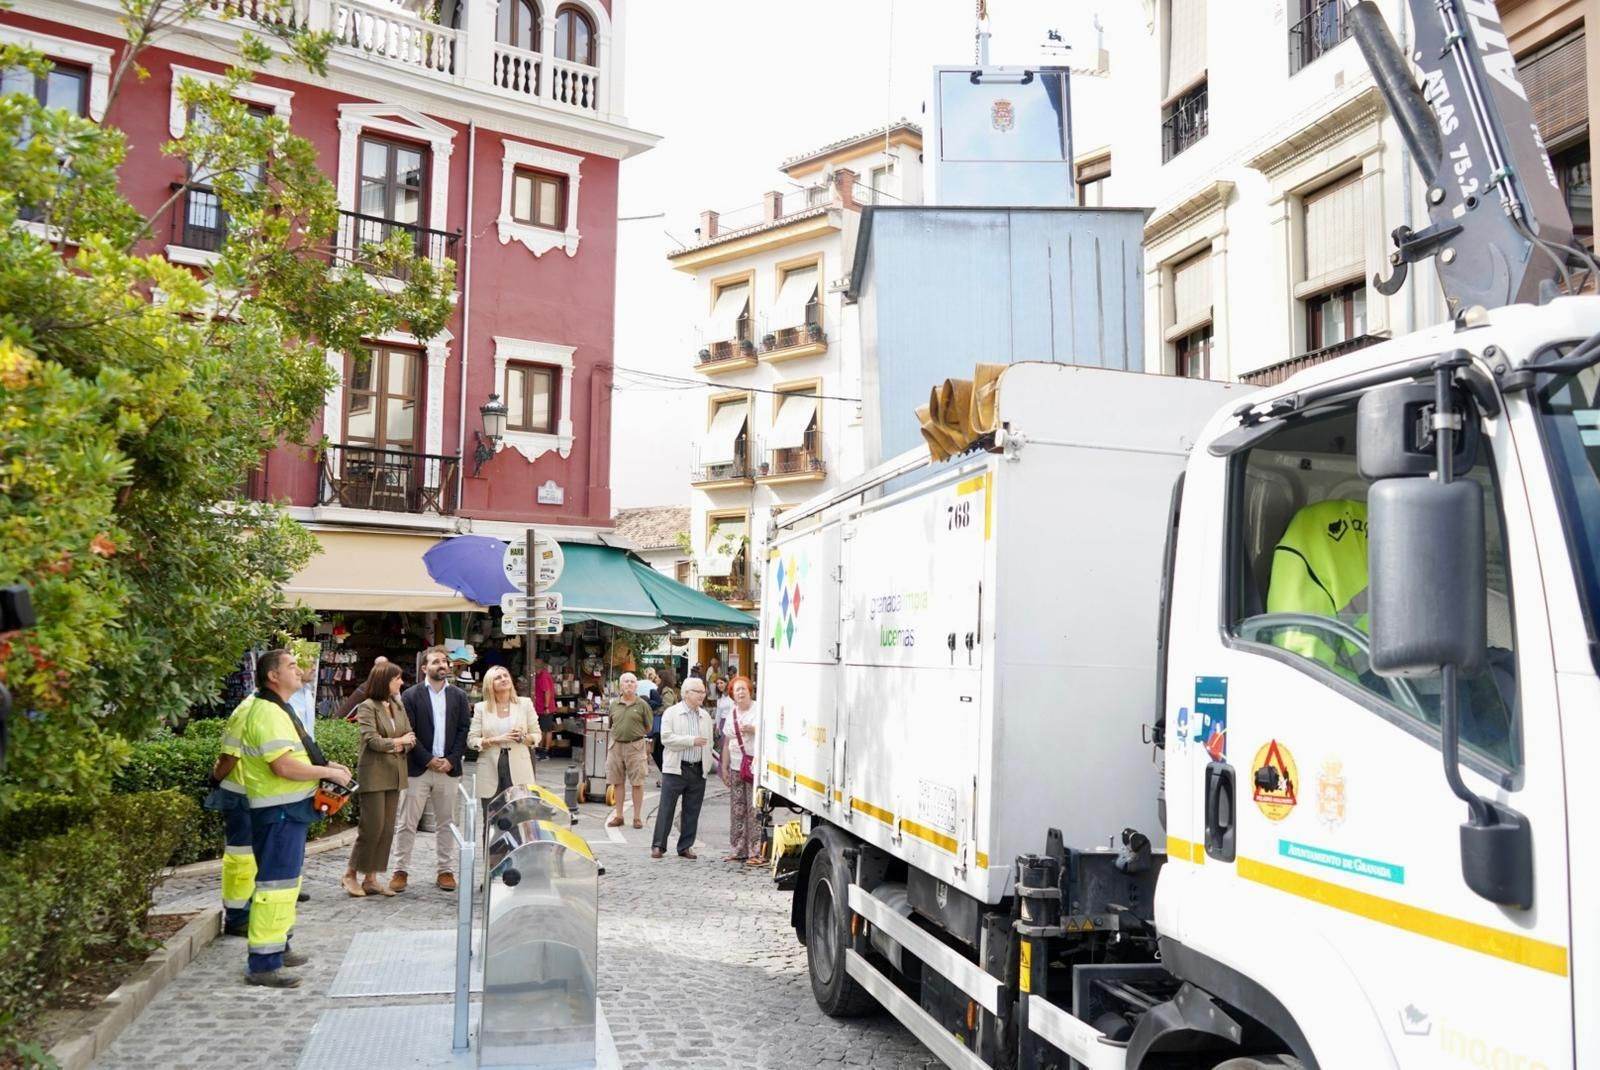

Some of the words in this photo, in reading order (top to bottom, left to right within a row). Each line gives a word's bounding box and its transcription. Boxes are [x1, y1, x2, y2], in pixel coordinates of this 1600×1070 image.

[1423, 68, 1459, 136] ATLAS
[1449, 142, 1479, 198] 75.2
[948, 500, 970, 531] 768
